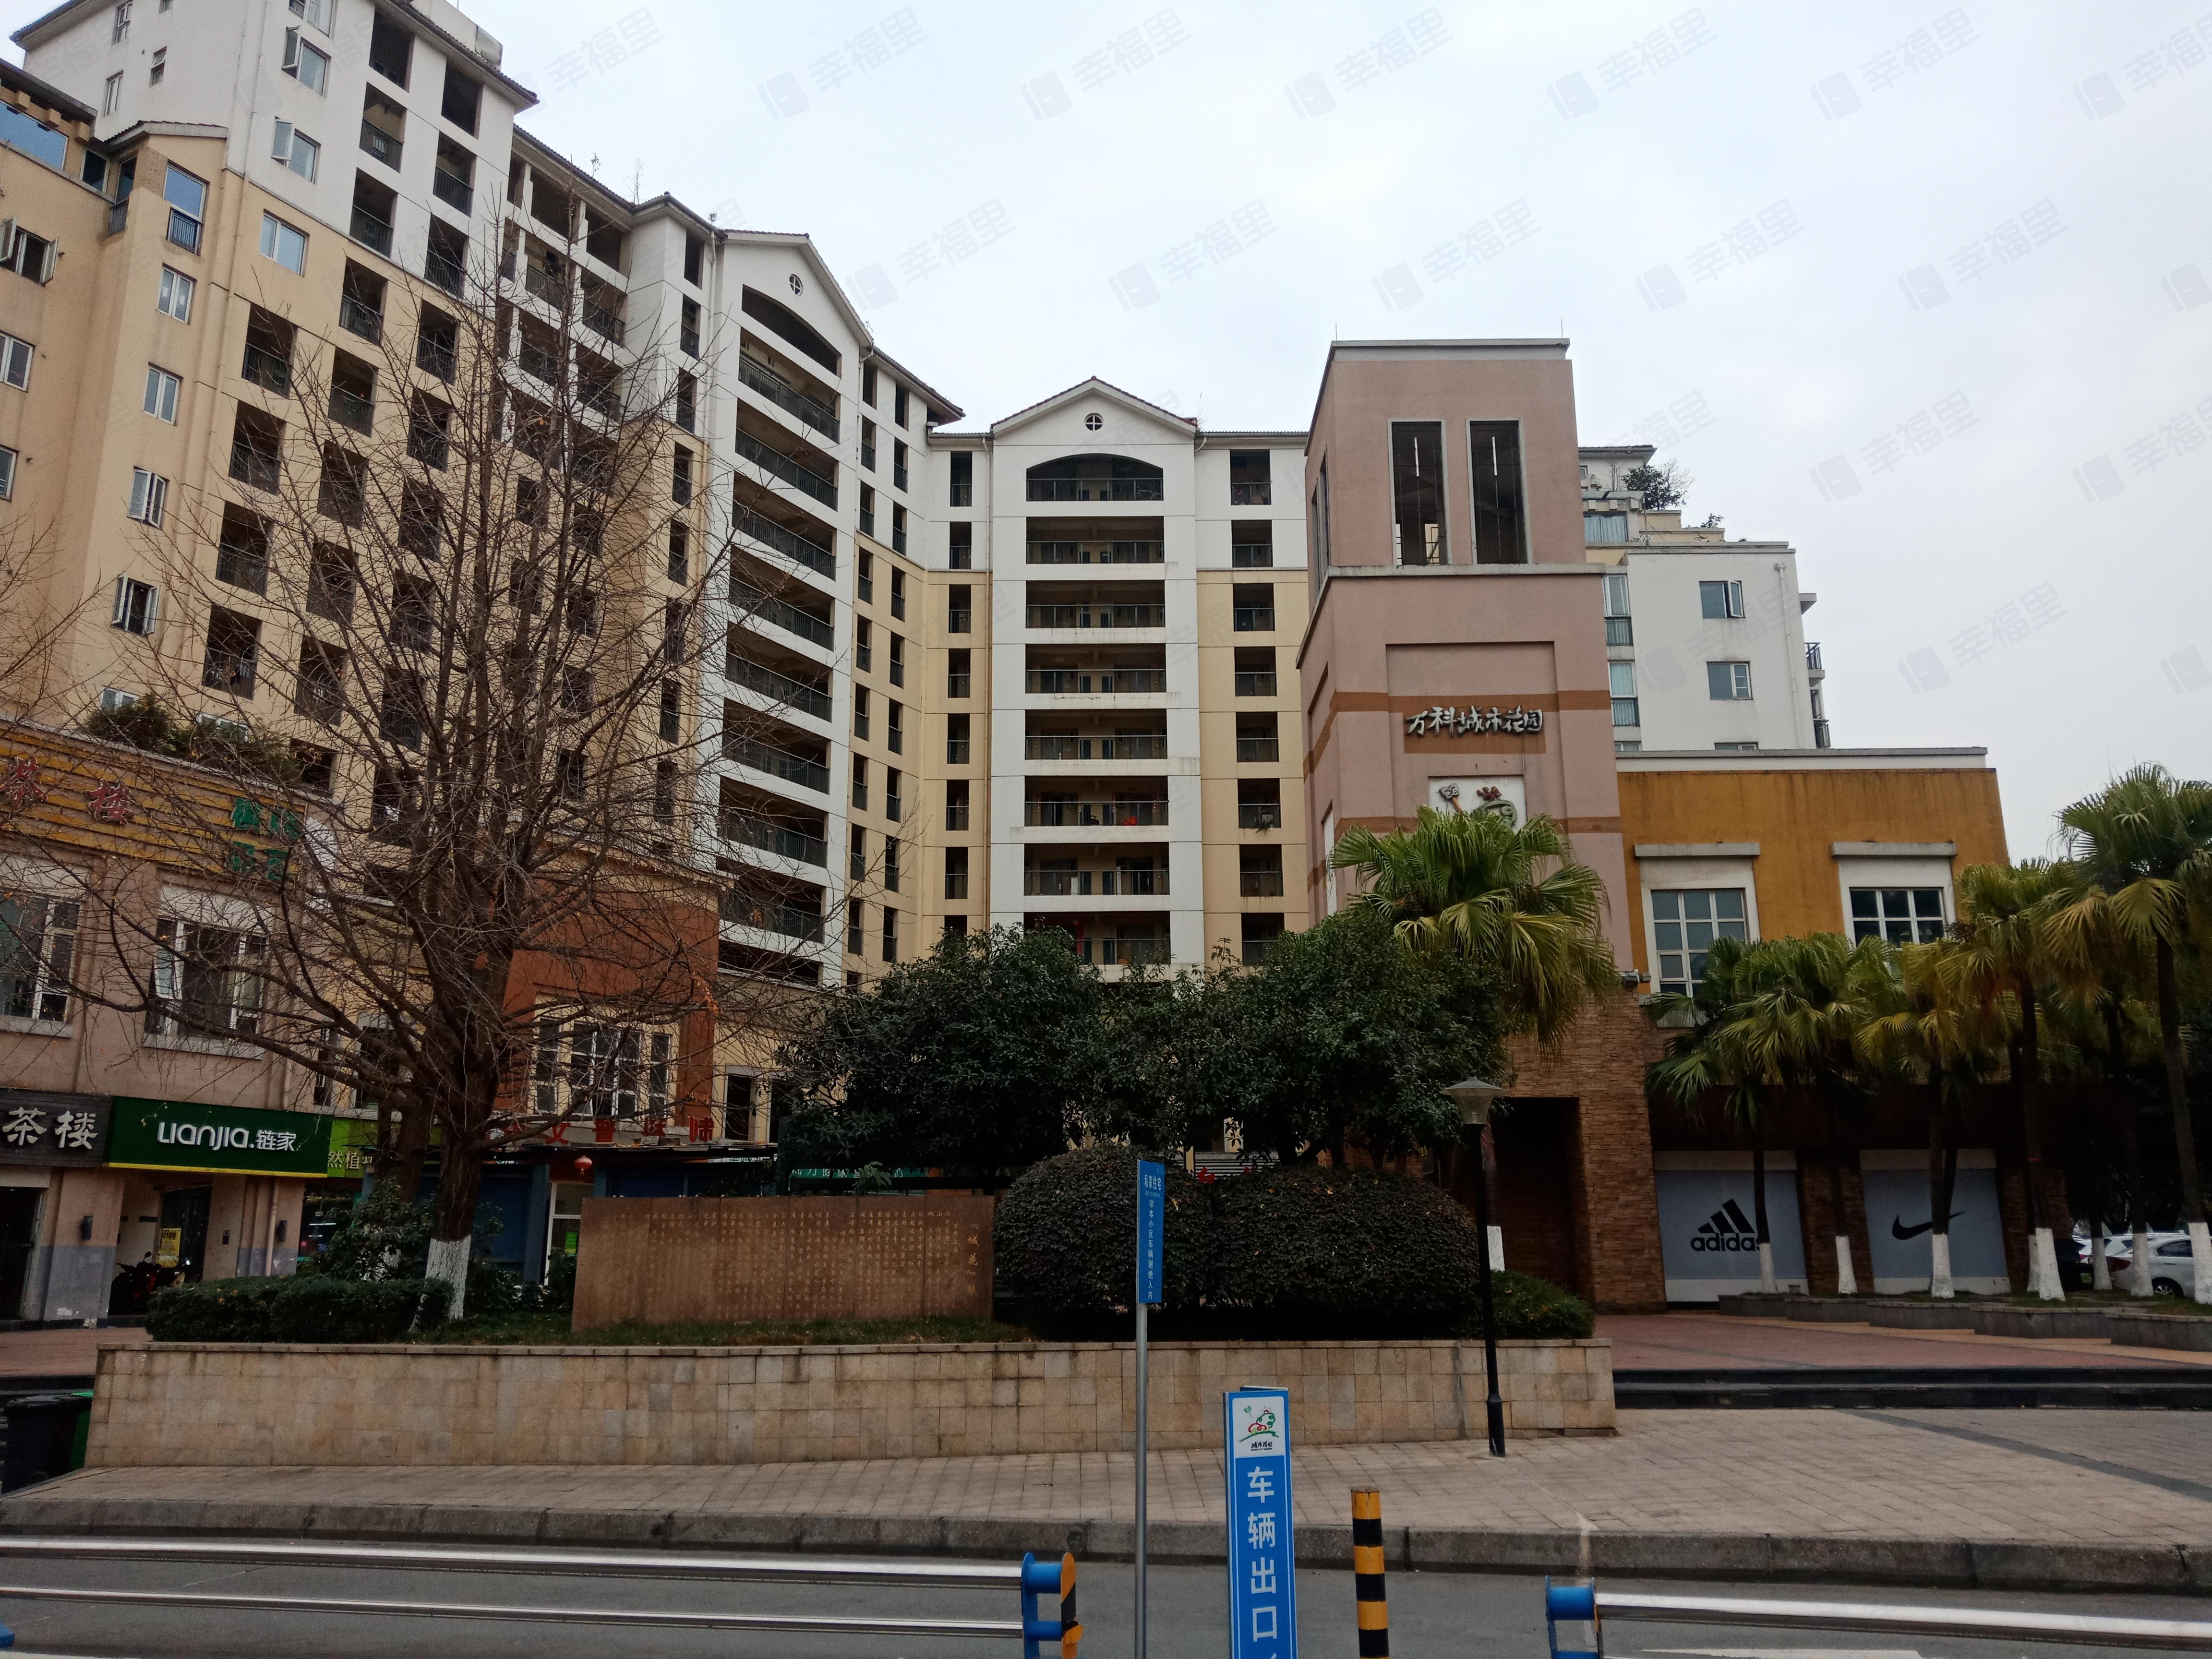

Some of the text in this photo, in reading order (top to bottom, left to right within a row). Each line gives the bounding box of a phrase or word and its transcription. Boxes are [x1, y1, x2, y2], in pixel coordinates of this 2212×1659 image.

[1406, 705, 1543, 737] 万科城市花园
[2, 1107, 98, 1149] 茶楼
[1144, 1175, 1161, 1190] 私家住宅
[1248, 1466, 1277, 1643] 车辆出口
